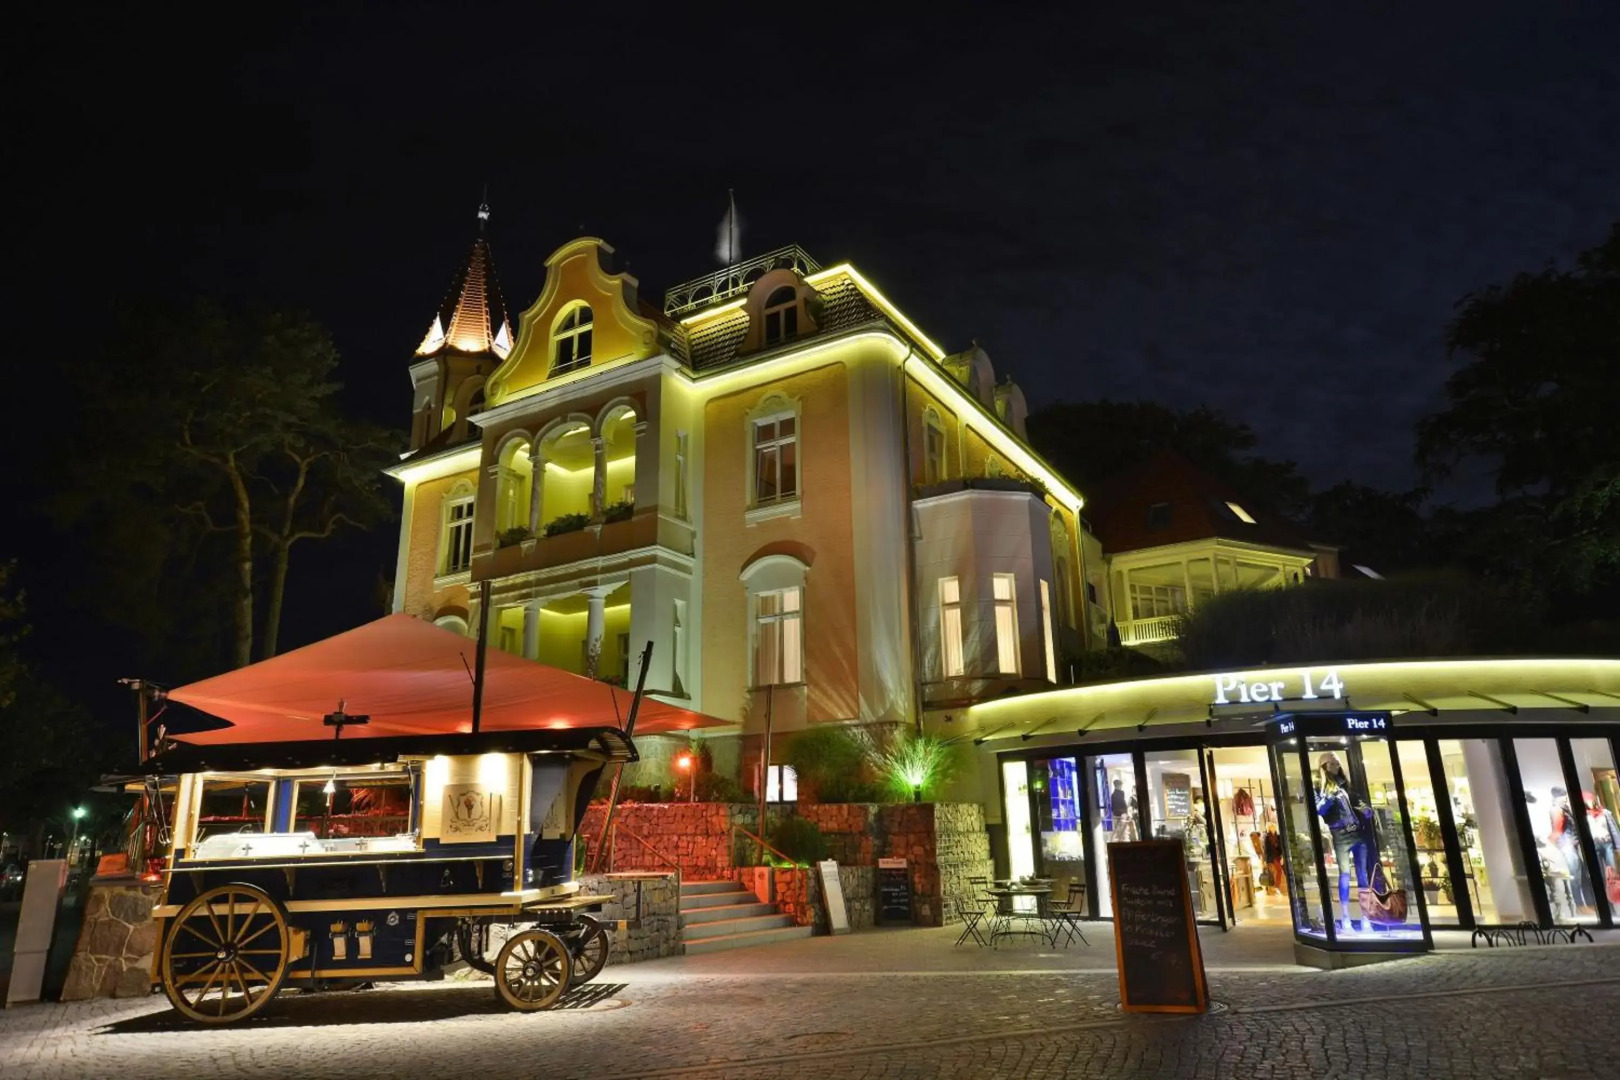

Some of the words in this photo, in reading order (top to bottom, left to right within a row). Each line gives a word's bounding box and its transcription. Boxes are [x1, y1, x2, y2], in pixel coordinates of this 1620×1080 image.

[1214, 674, 1285, 704] Pier
[1300, 669, 1343, 700] 14
[1280, 723, 1288, 734] Pier
[1288, 721, 1295, 732] 14
[1346, 718, 1369, 729] Pier
[1372, 718, 1386, 729] 14
